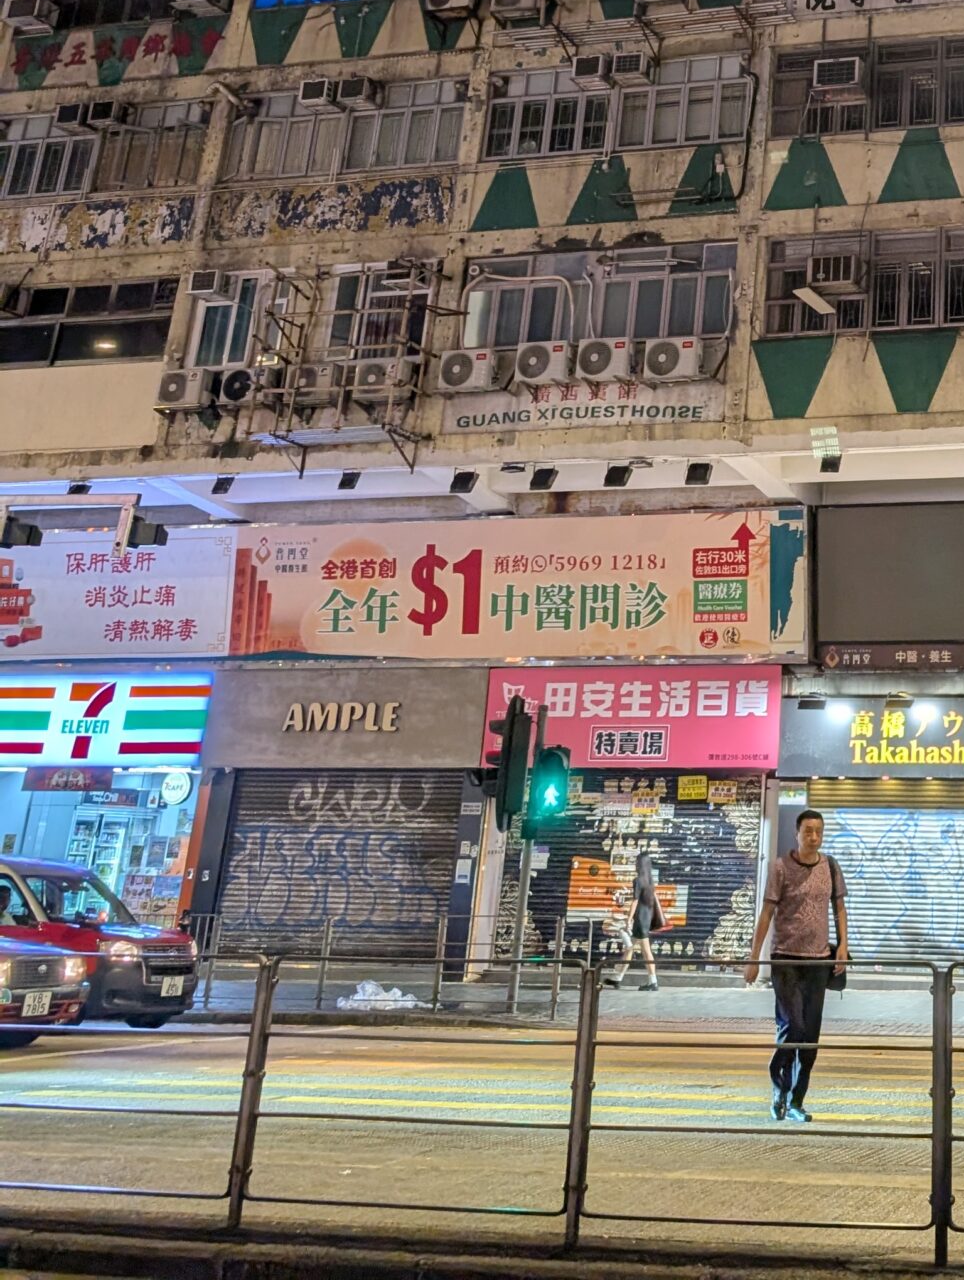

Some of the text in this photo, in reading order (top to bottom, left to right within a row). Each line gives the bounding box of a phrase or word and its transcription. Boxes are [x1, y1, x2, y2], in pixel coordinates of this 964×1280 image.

[457, 410, 531, 428] GUANG
[65, 550, 157, 575] 保肝護肝
[494, 556, 530, 575] 預約
[696, 550, 746, 564] 右行30米
[320, 558, 397, 581] 全港首創
[84, 585, 177, 608] 消炎止痛
[317, 587, 401, 634] 全年
[407, 543, 483, 636] $1
[490, 581, 669, 631] 中醫問診
[698, 582, 742, 599] 醫療券
[103, 618, 199, 642] 清熱解毒
[544, 681, 769, 718] 田安生活百貨
[282, 702, 400, 732] AMPLE
[595, 730, 662, 756] 特賣場
